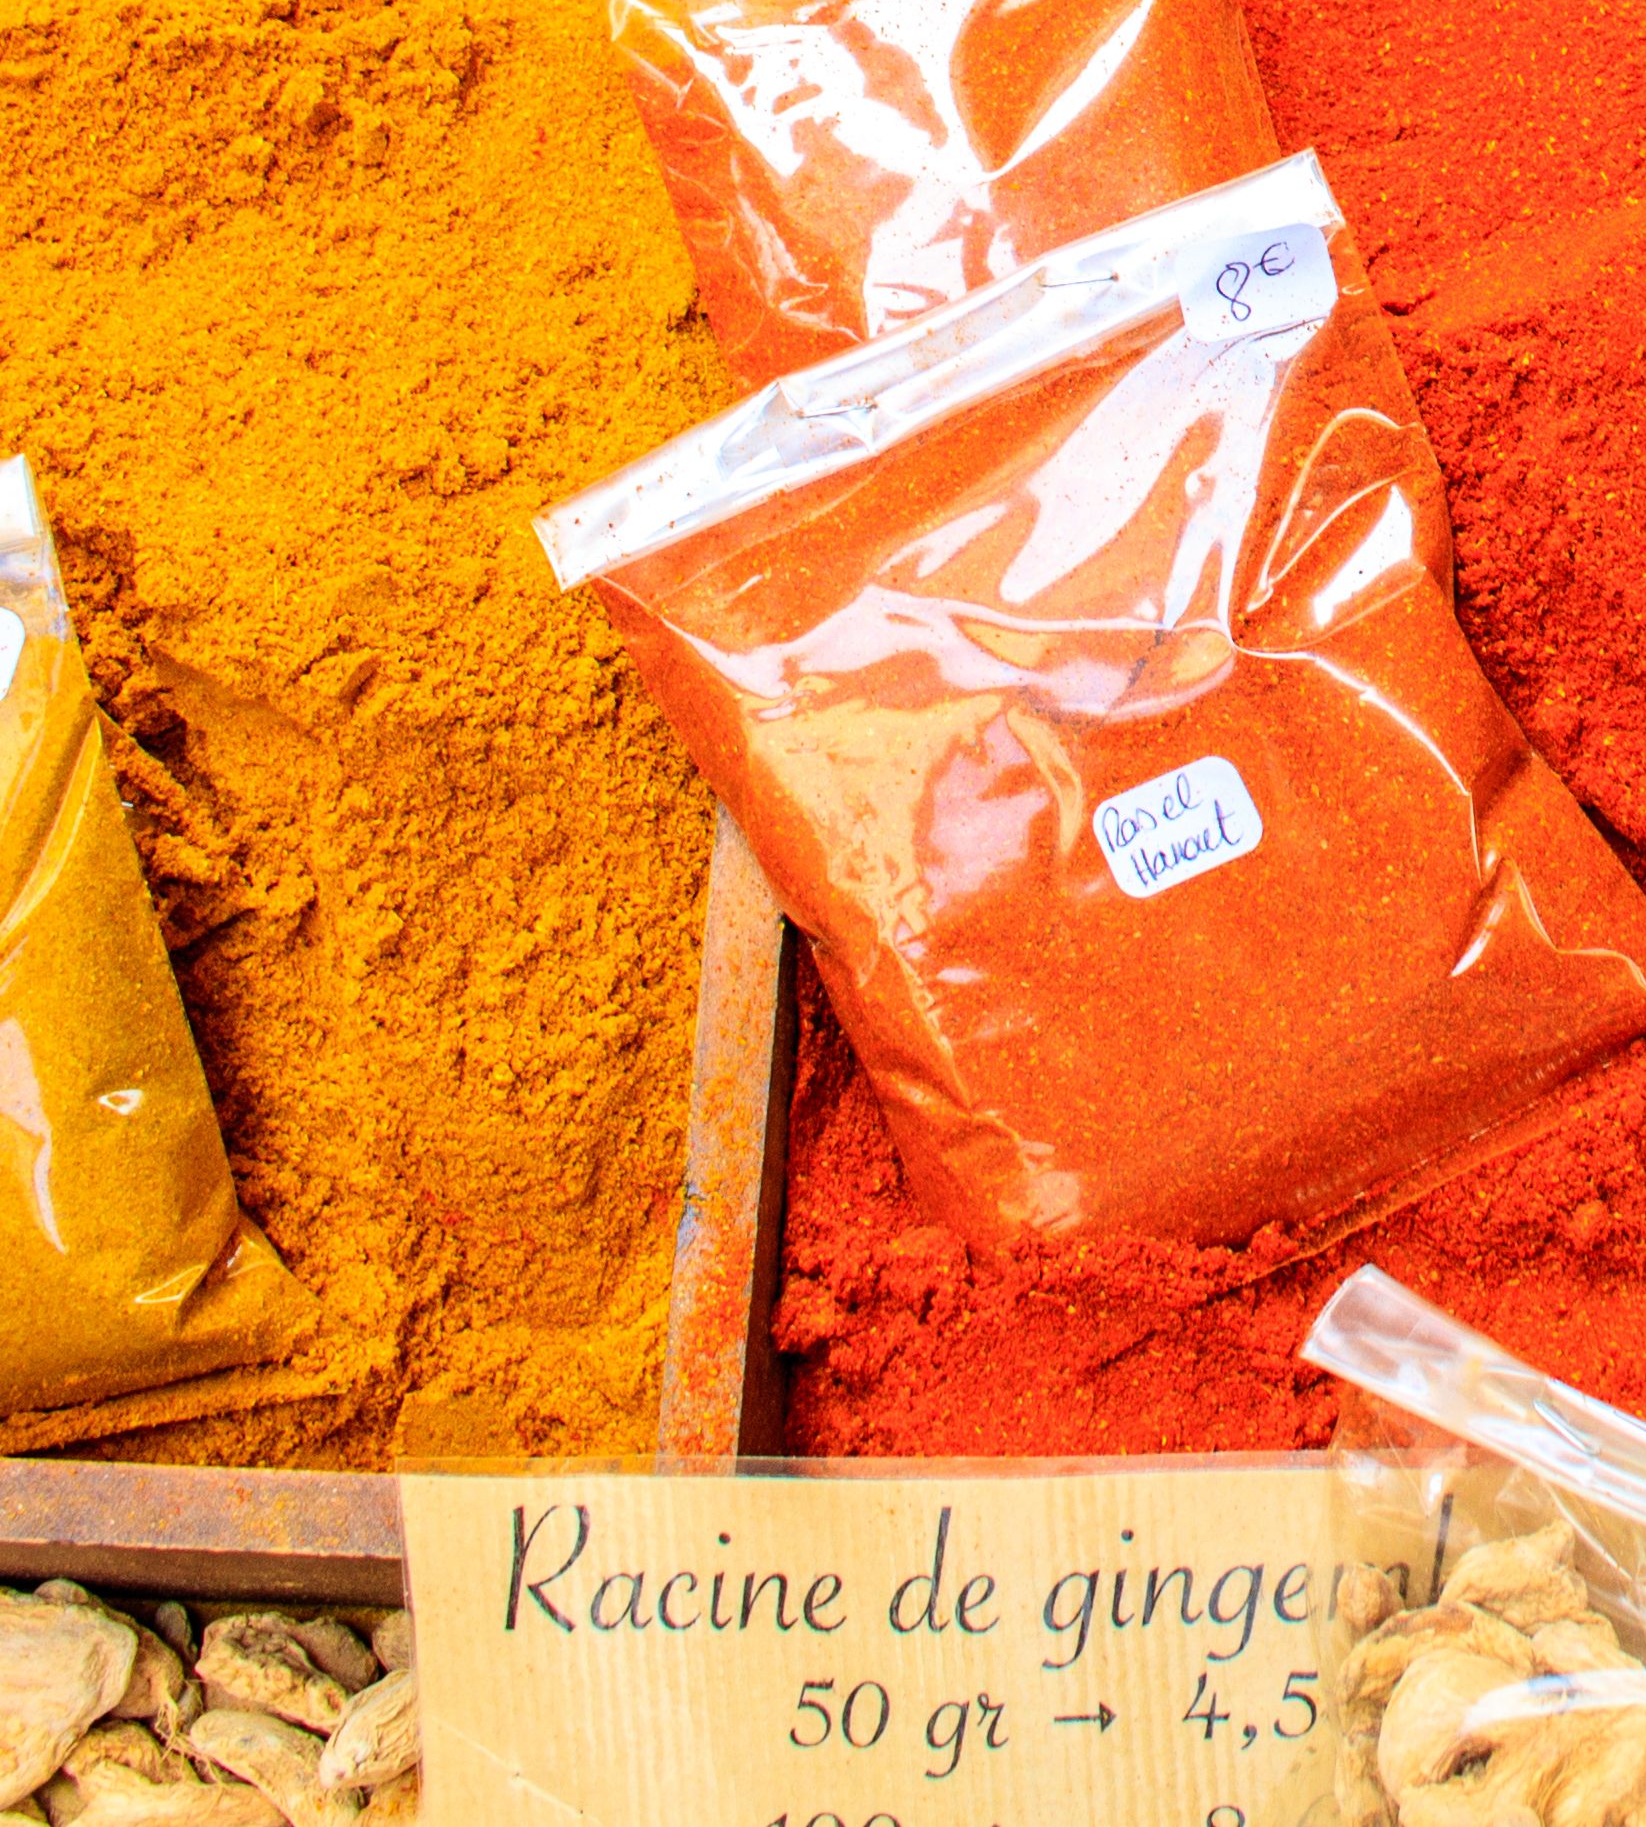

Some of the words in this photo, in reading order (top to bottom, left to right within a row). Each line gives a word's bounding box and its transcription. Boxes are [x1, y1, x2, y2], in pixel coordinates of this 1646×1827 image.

[505, 1506, 848, 1633] Racine
[889, 1507, 1000, 1635] de
[790, 1679, 890, 1751] 50
[924, 1689, 1010, 1778] gr
